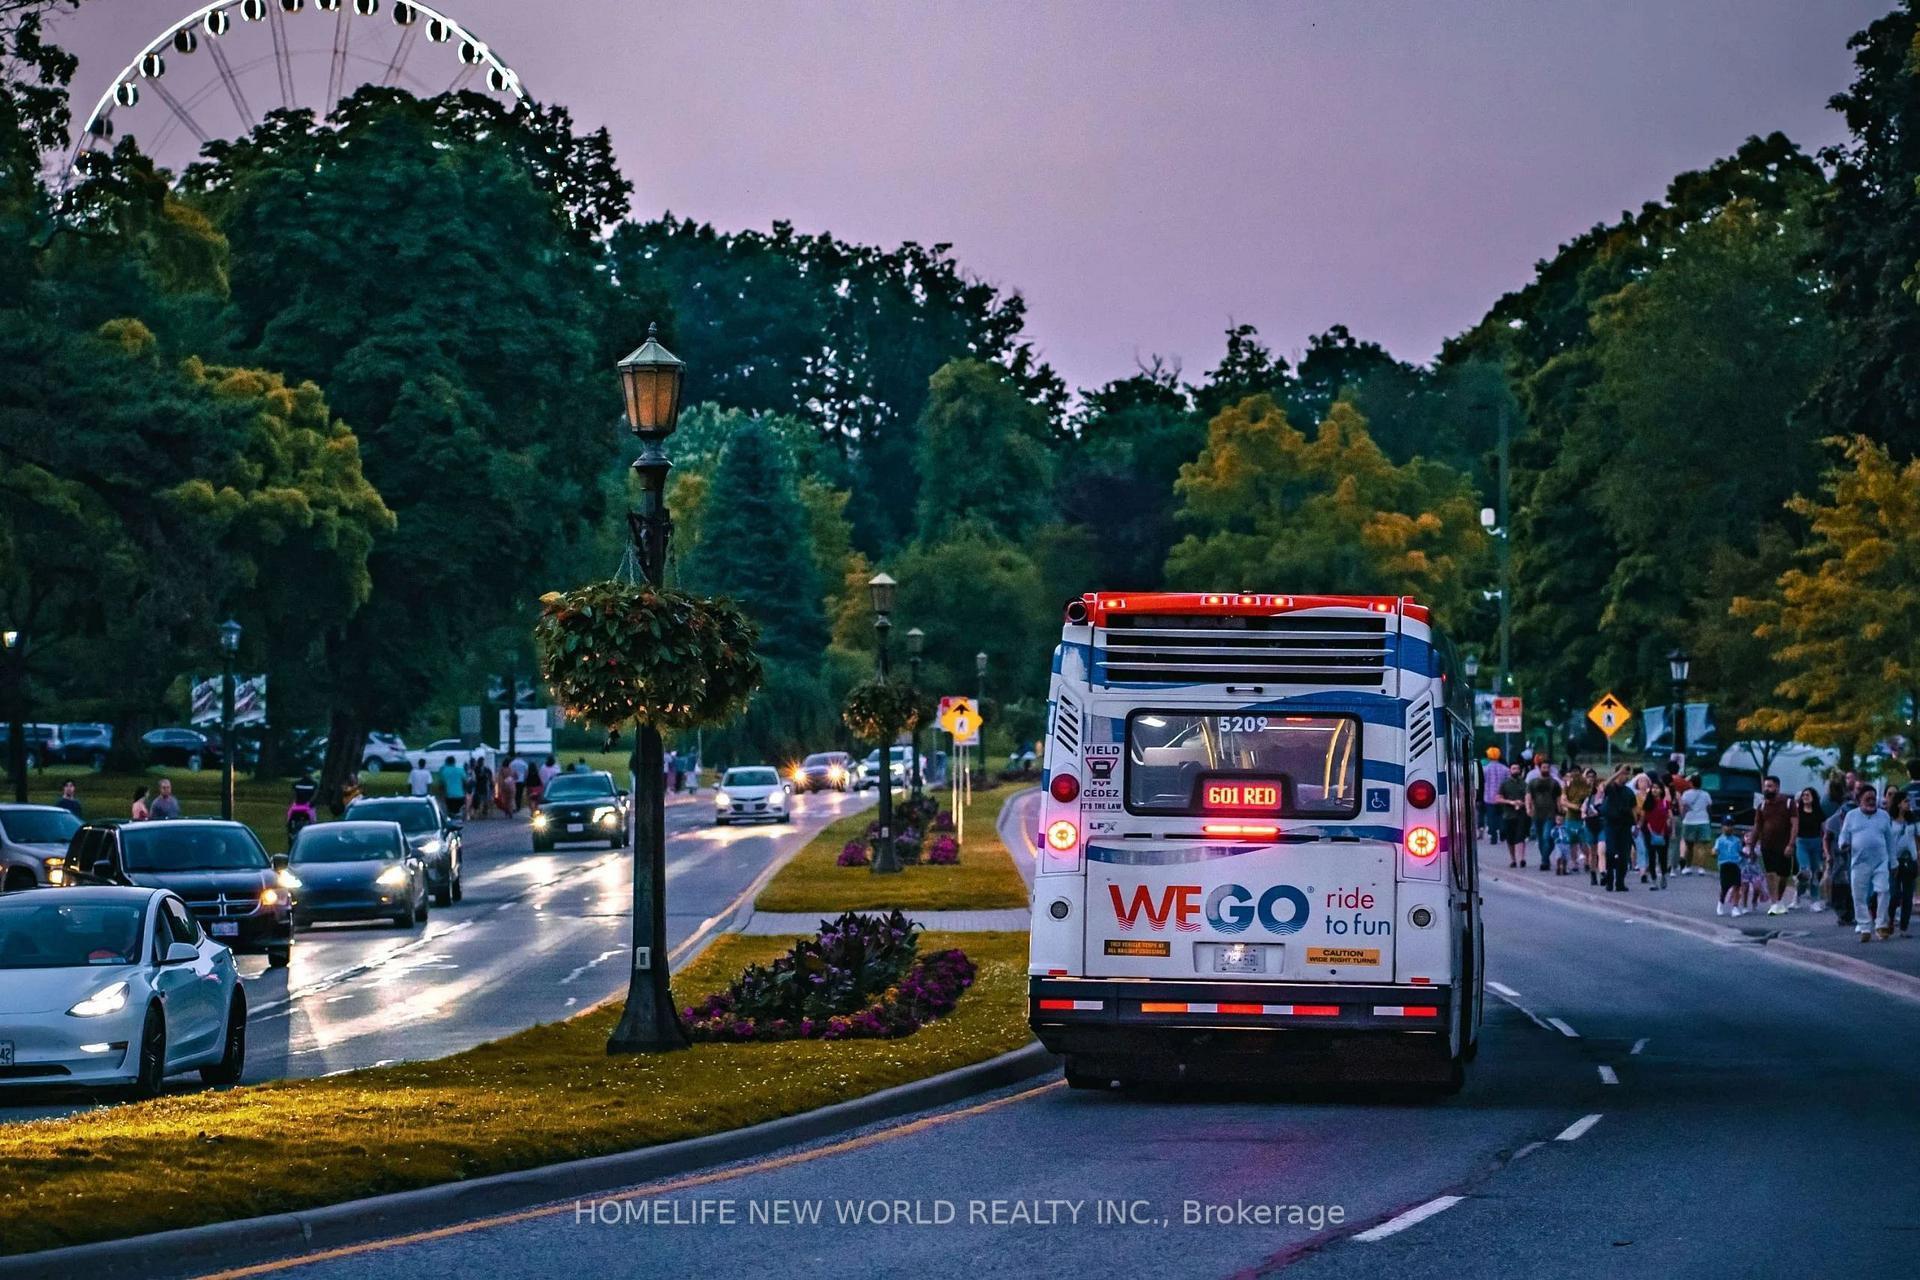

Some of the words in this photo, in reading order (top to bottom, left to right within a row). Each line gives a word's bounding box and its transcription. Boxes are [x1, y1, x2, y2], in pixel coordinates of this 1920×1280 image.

[1220, 716, 1268, 732] 5209
[1084, 746, 1120, 755] YIELD
[1083, 788, 1119, 797] CÉDEZ
[1208, 787, 1239, 804] 601
[1243, 787, 1277, 805] RED
[1326, 886, 1375, 909] ride
[1325, 914, 1349, 935] to
[1354, 913, 1391, 935] fun
[1322, 949, 1364, 957] CAUTION
